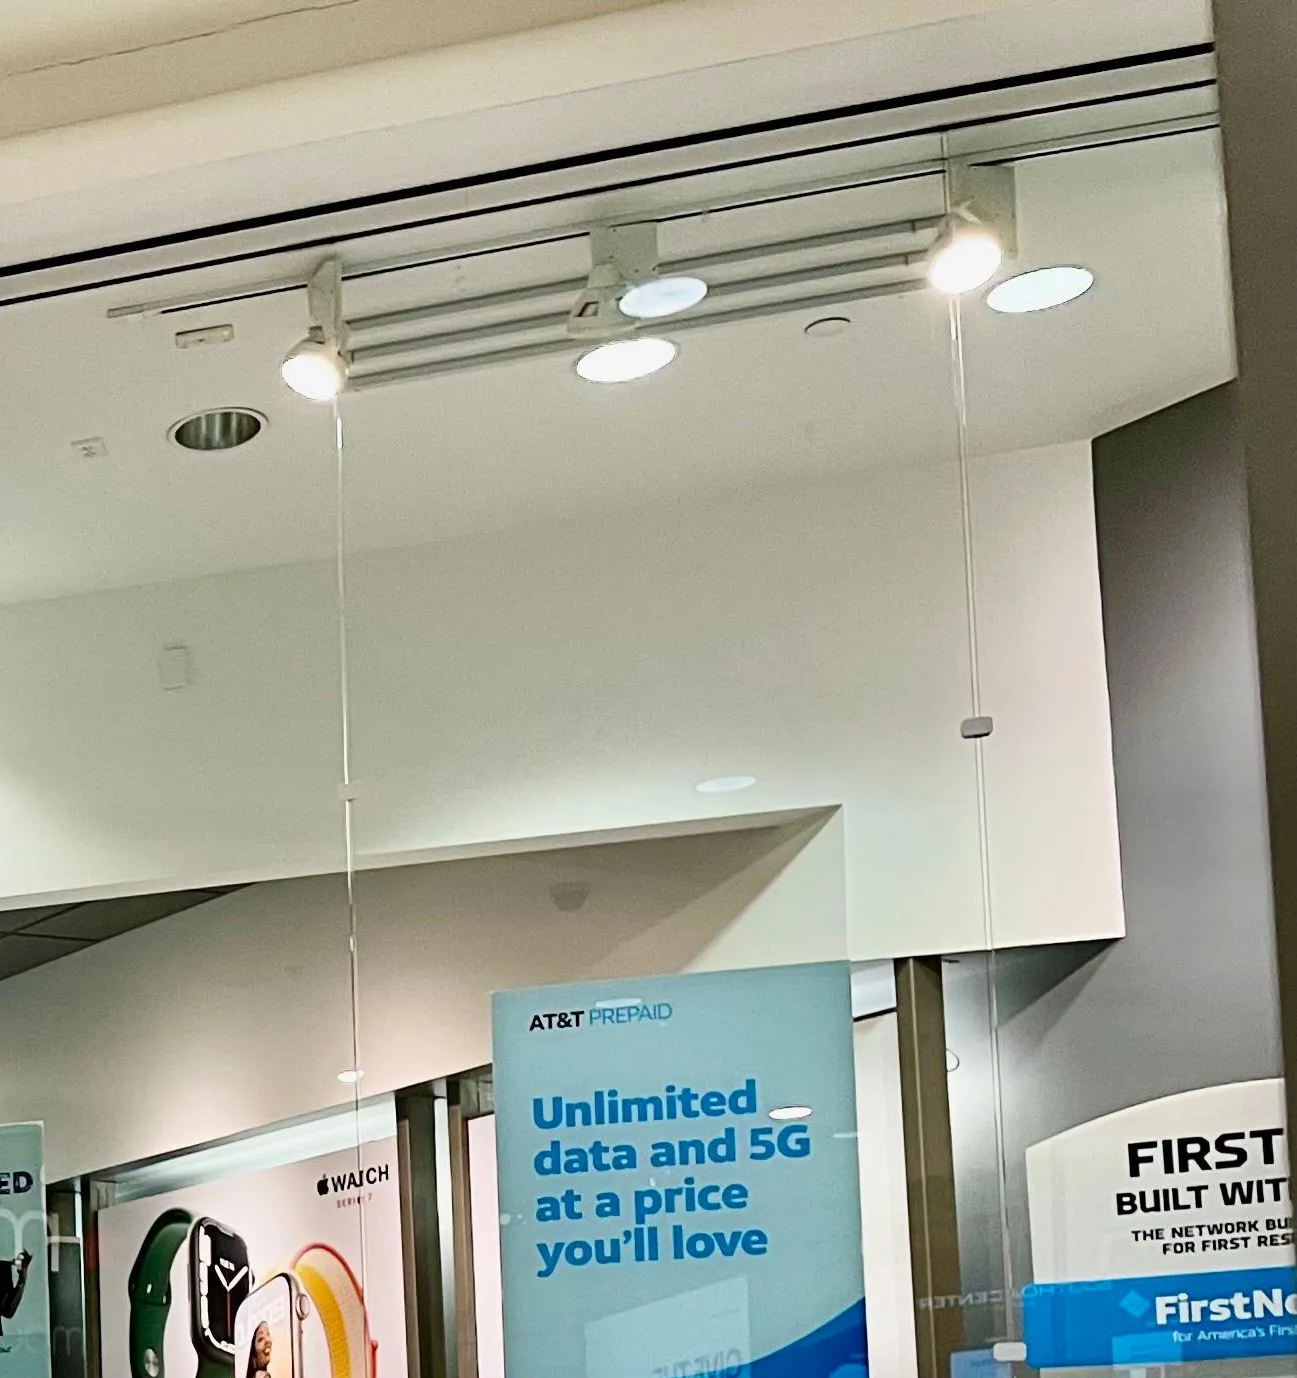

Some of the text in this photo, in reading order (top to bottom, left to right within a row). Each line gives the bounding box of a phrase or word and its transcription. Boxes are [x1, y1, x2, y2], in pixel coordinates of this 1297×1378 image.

[529, 1002, 672, 1031] AT&T PREPAID
[533, 1079, 757, 1129] Unlimited
[533, 1125, 811, 1176] data and 5G
[1128, 1128, 1284, 1177] FIRST
[331, 1164, 389, 1192] WATCH
[536, 1177, 748, 1225] at a price
[1116, 1185, 1209, 1216] BUILT
[1131, 1229, 1165, 1242] THE
[1171, 1220, 1259, 1239] NETWORK
[1163, 1242, 1195, 1255] FOR
[1201, 1237, 1251, 1252] FIRST
[536, 1225, 768, 1278] you'll love
[1173, 1331, 1193, 1342] for
[1197, 1327, 1265, 1341] America's
